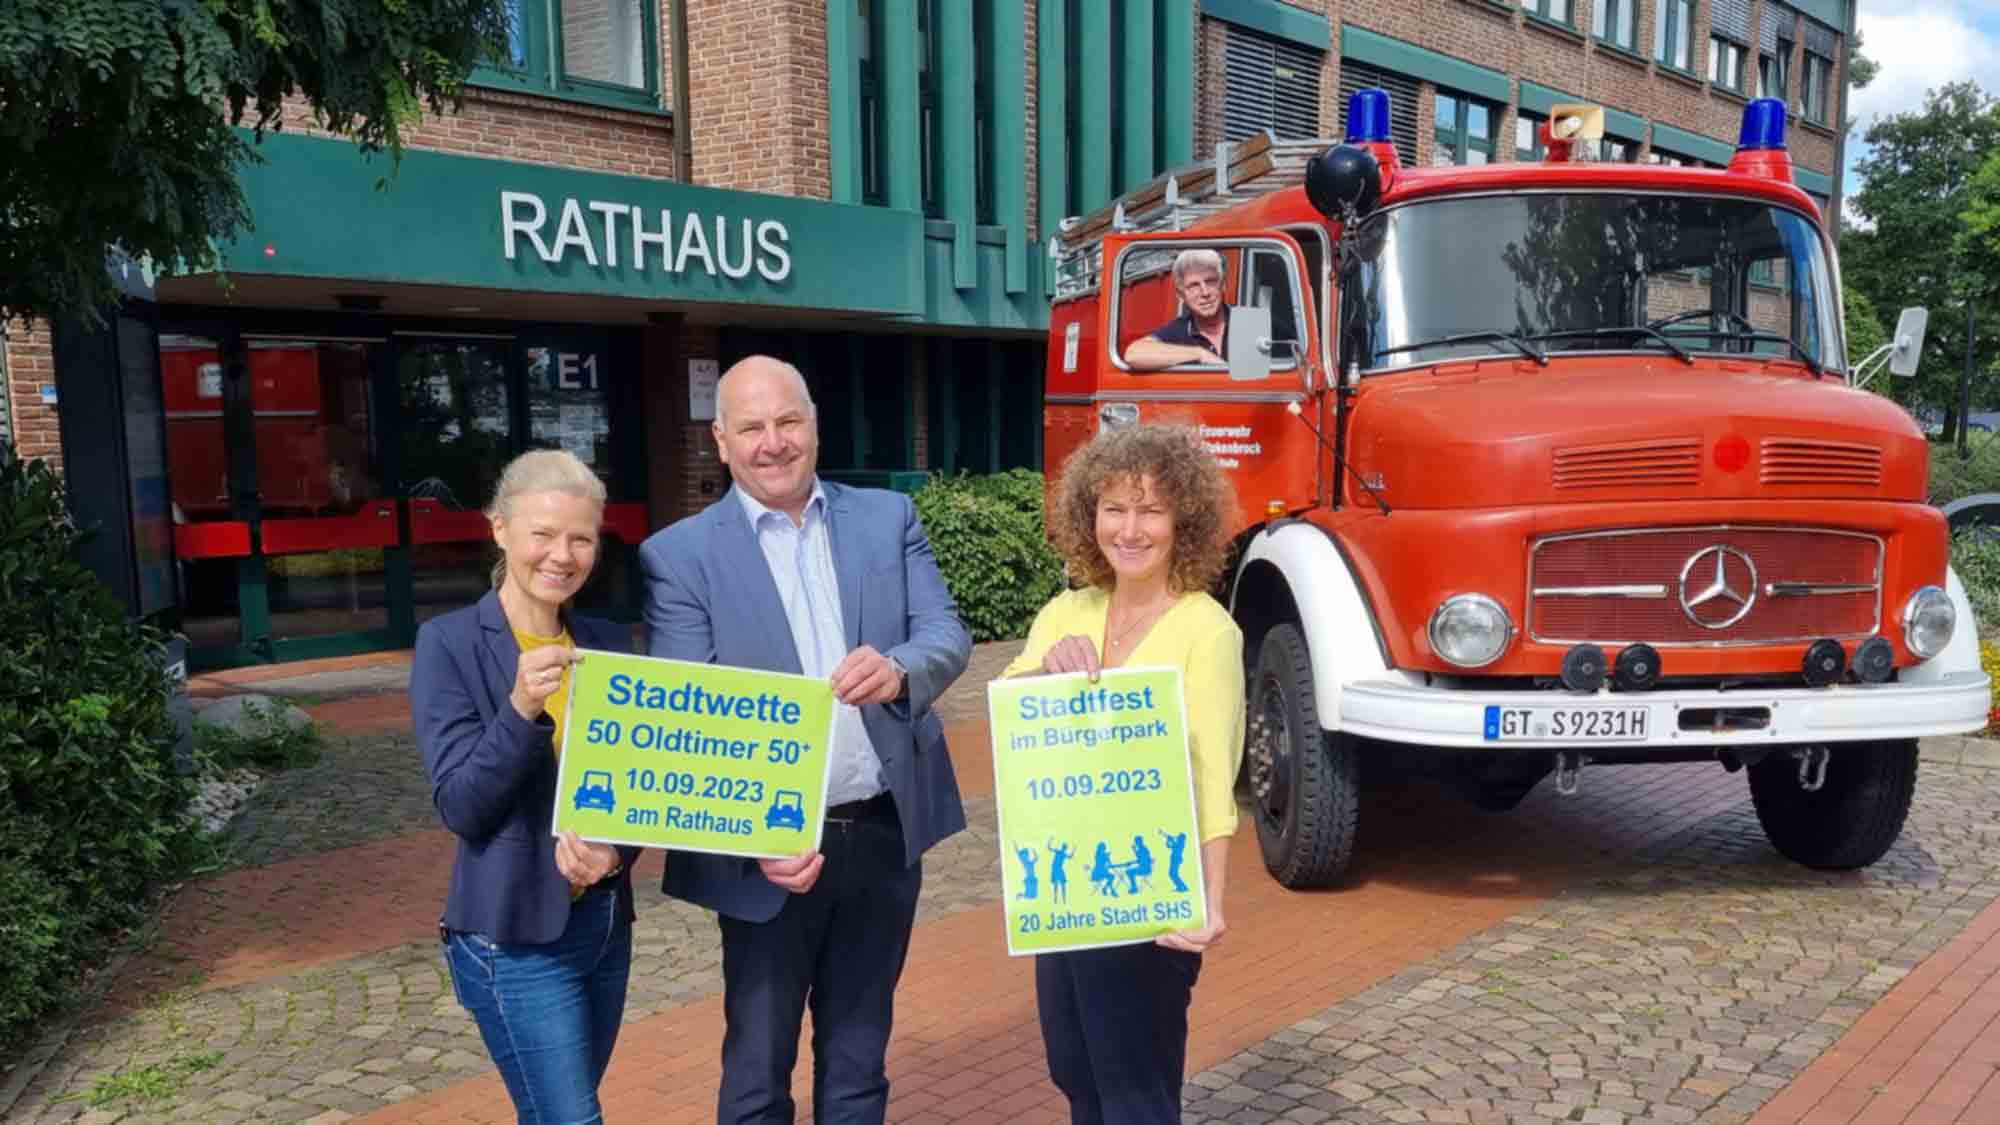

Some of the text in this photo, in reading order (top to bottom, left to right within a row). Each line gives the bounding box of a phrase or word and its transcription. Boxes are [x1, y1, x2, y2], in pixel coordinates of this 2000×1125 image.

[501, 191, 792, 281] RATHAUS
[558, 352, 599, 389] E1
[607, 673, 801, 724] Stadtwette
[1019, 687, 1155, 720] Stadtfest
[586, 719, 621, 745] 50
[631, 723, 759, 760] Oldtimer
[1010, 719, 1168, 750] im Bürgerpark
[1502, 710, 1533, 736] GT
[626, 768, 764, 803] 10.09.2023
[1028, 768, 1162, 800] 10.09.2023
[625, 806, 753, 836] am Rathaus
[1019, 900, 1193, 933] 20 Jahre Stadt SHS
